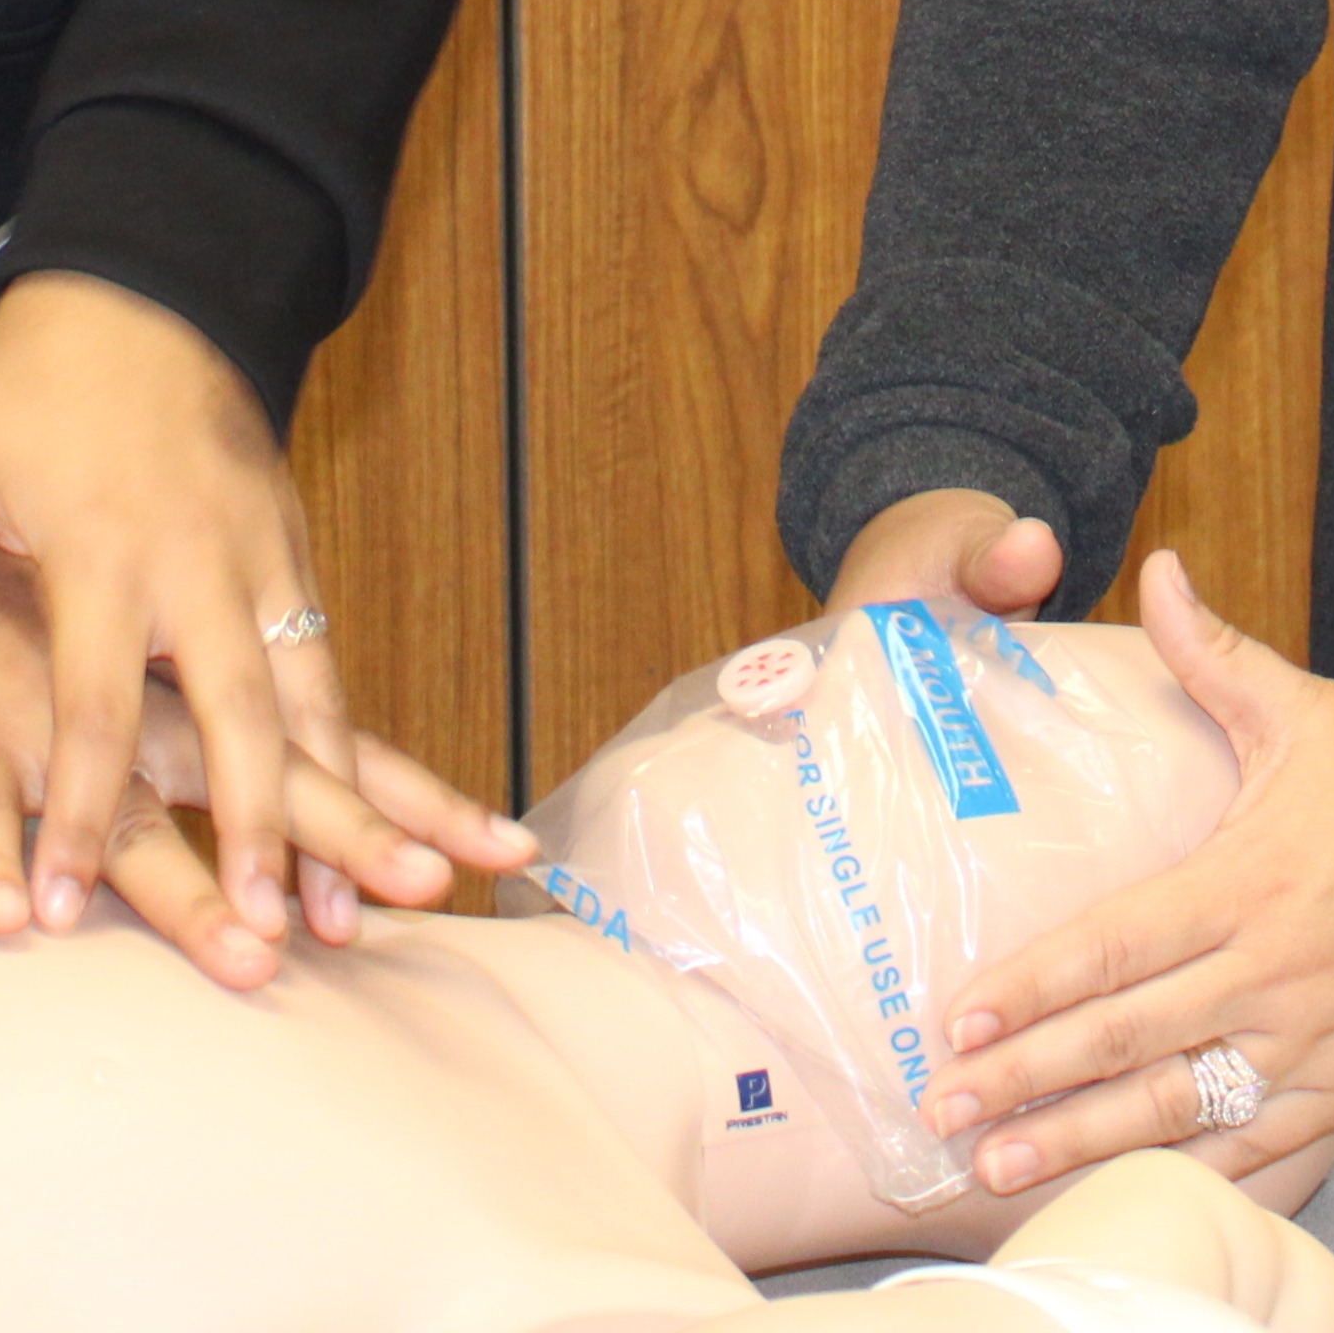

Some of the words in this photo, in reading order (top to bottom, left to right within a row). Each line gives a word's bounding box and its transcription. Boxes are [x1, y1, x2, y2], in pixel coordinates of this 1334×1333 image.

[547, 864, 630, 953] FDA
[783, 708, 823, 788] FOR
[806, 793, 881, 932] SINGLE
[862, 938, 912, 1020] USE
[890, 1026, 931, 1108] ONL
